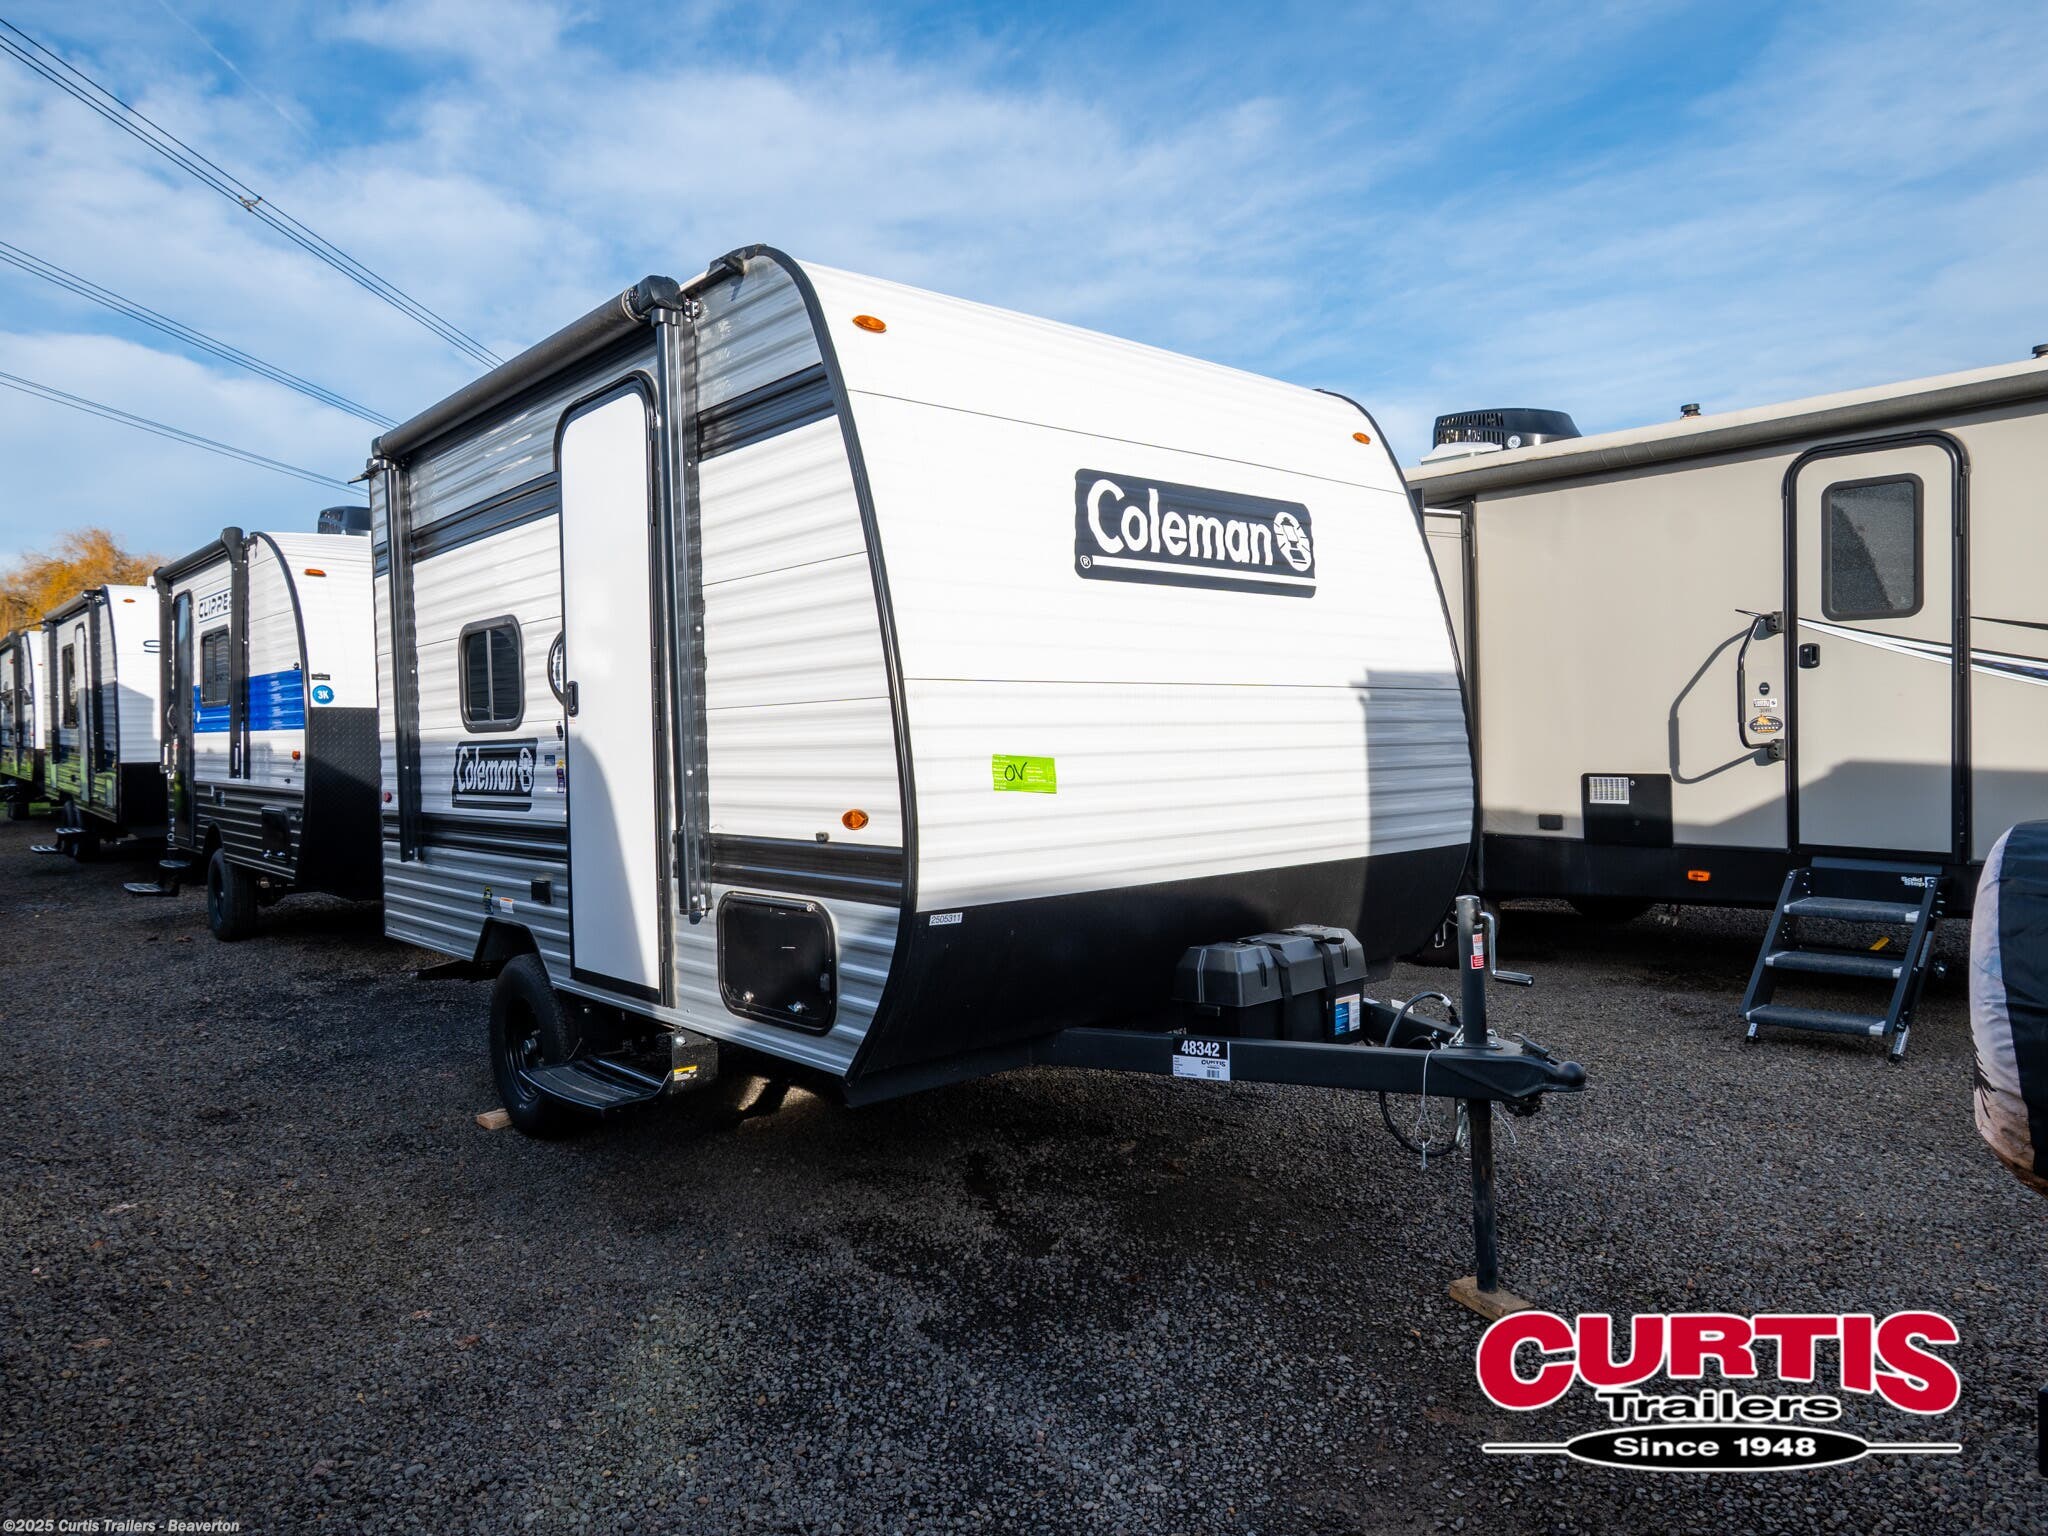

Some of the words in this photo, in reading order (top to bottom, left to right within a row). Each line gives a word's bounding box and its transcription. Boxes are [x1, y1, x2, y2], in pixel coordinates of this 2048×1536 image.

[1087, 479, 1273, 566] Coleman
[317, 690, 330, 700] 3K
[457, 746, 518, 792] Coleman
[1181, 1040, 1220, 1057] 48342
